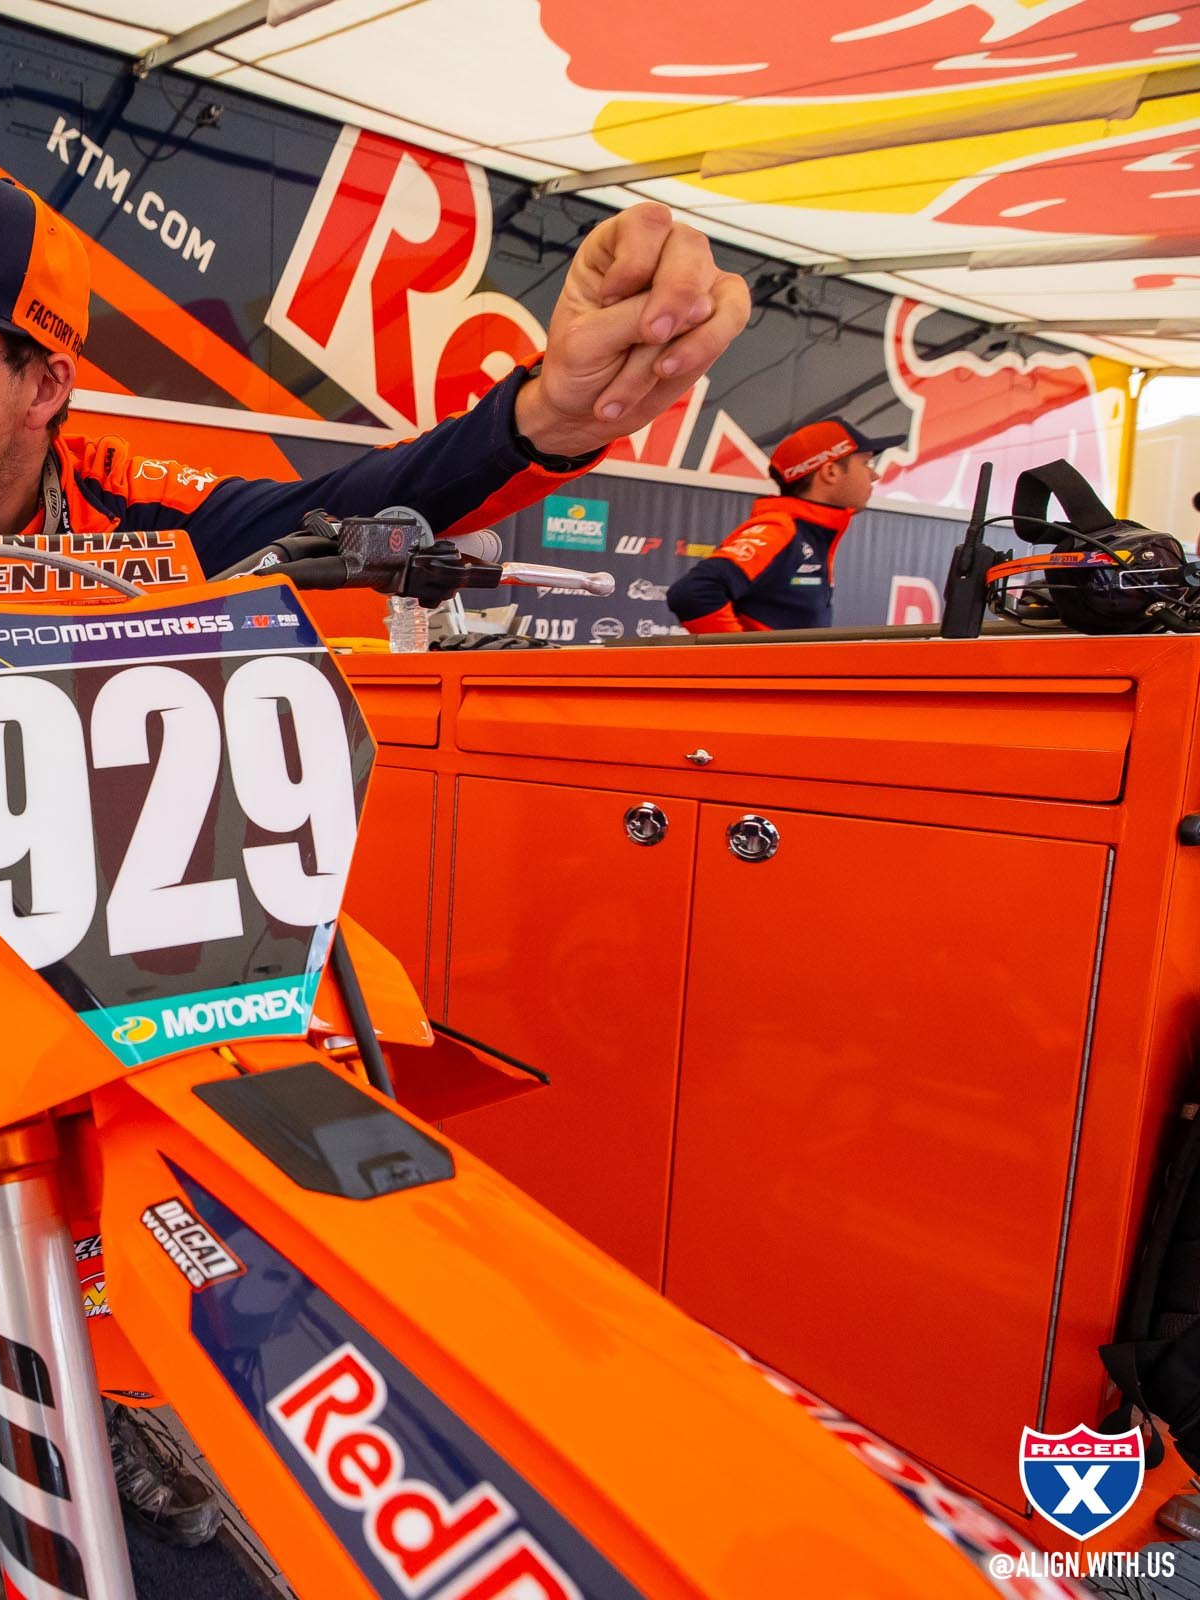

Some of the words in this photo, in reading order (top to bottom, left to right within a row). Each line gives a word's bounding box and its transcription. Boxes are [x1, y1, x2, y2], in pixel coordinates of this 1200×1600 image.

[46, 116, 216, 273] KTM.COM
[26, 299, 74, 347] FACTORY
[547, 517, 603, 536] MOTOREX
[615, 535, 663, 555] WP
[241, 614, 278, 629] AMA
[161, 987, 305, 1039] MOTOREX
[141, 1210, 205, 1288] WORKS
[154, 1200, 239, 1280] DECAL
[271, 1344, 511, 1589] Red
